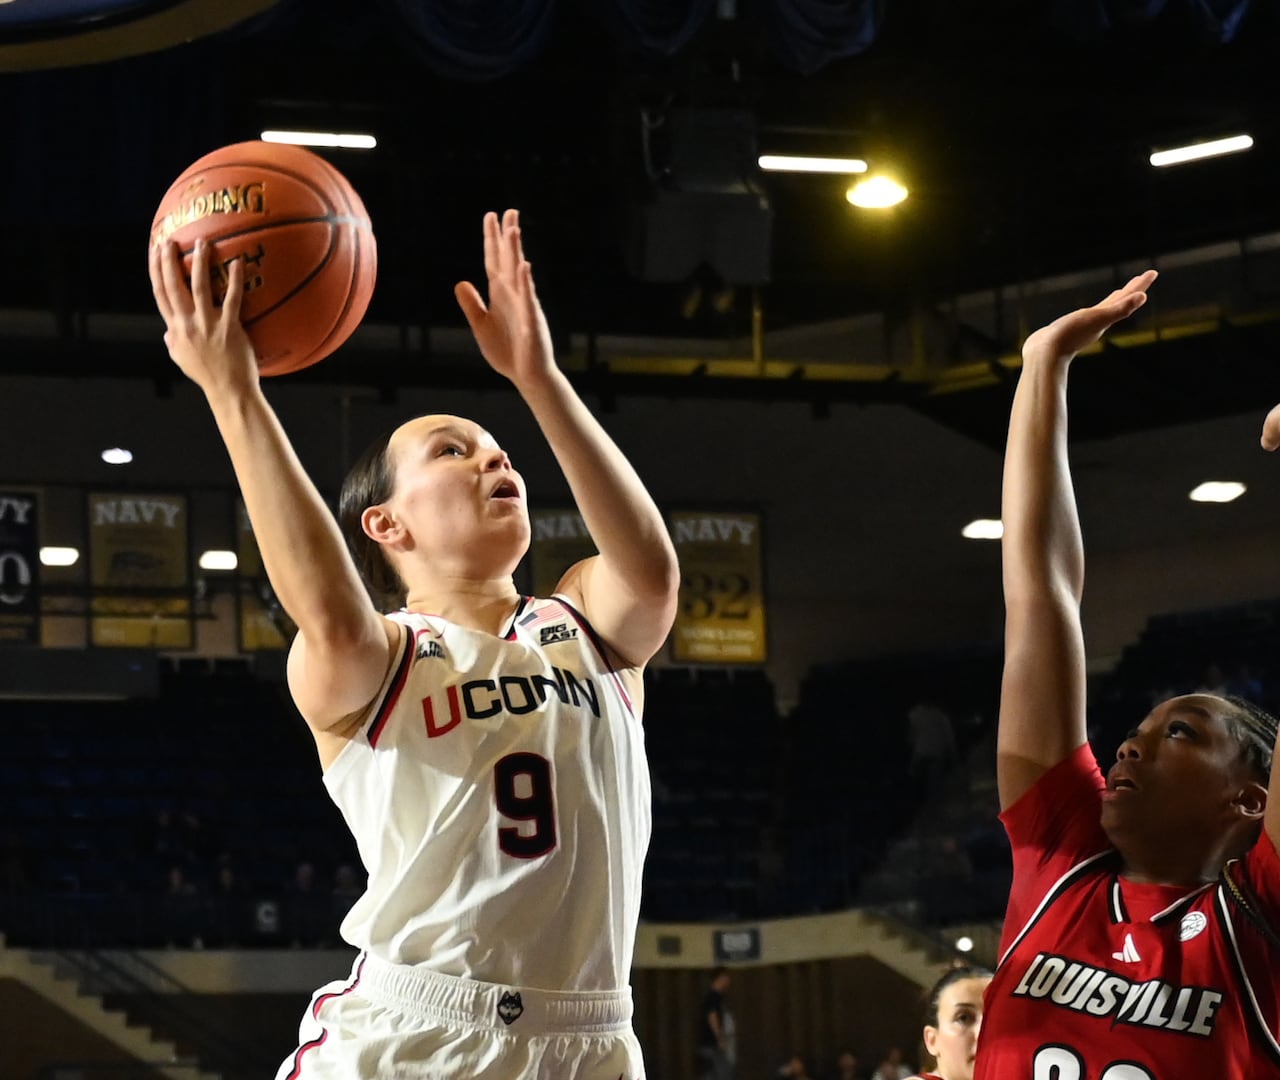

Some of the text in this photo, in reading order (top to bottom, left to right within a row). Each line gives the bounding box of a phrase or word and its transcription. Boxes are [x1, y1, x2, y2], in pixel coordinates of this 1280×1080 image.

[94, 501, 181, 529] NAVY
[676, 518, 757, 545] NAVY
[540, 623, 567, 635] BIG
[540, 627, 579, 642] EAST
[421, 666, 601, 738] UCONN
[493, 751, 558, 859] 9
[1012, 953, 1222, 1037] LOUISVILLE
